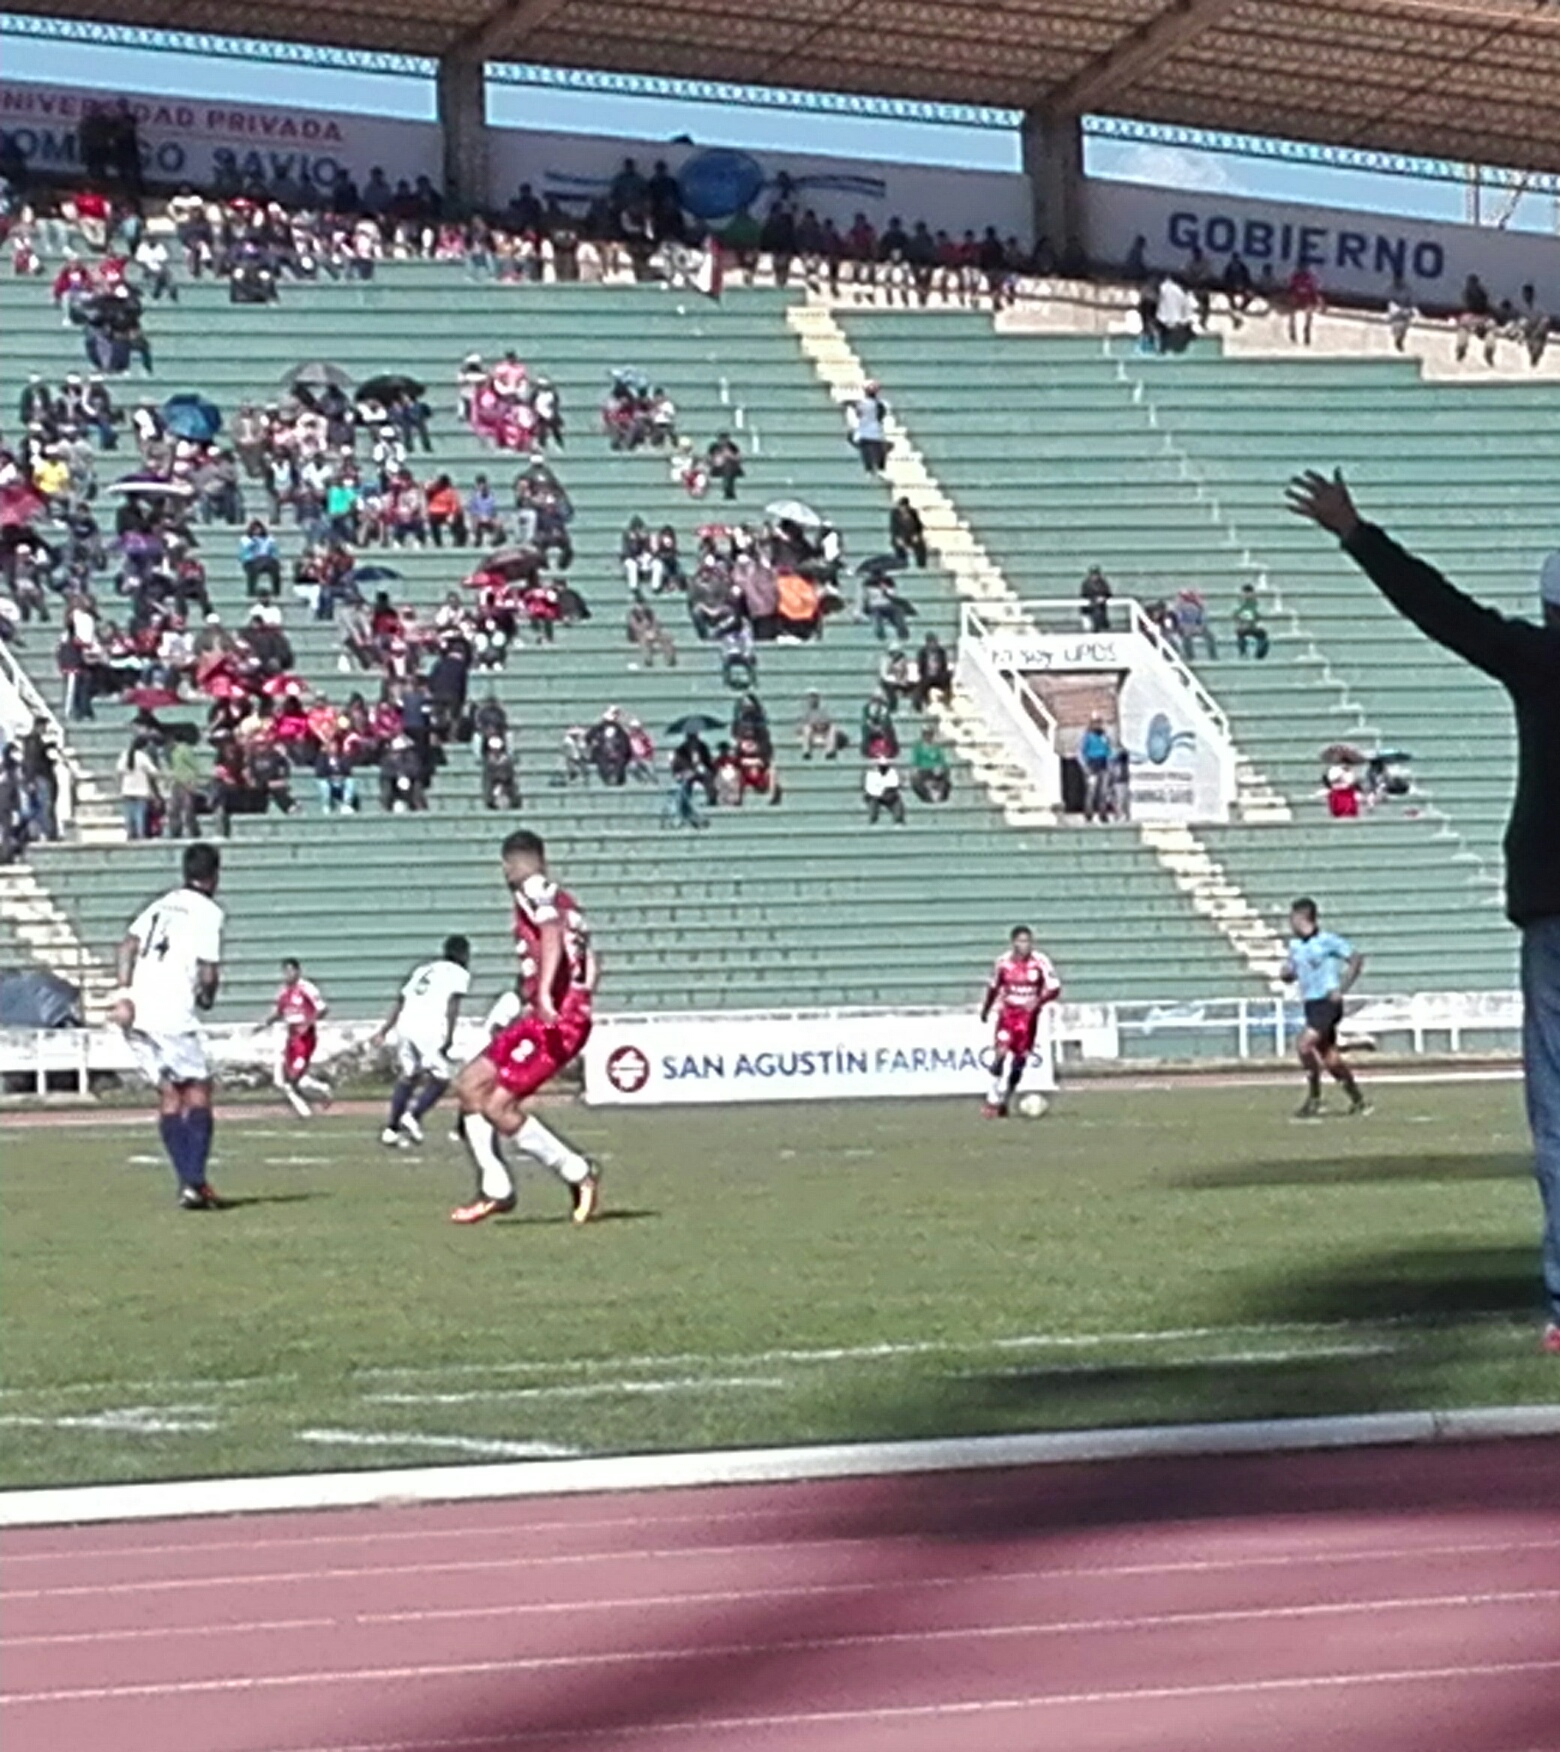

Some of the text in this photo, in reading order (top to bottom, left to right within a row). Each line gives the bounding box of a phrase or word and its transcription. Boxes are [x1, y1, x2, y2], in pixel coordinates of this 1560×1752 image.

[207, 109, 341, 141] PRIVADA
[1168, 212, 1444, 279] GOBIERNO
[141, 912, 170, 962] 14
[662, 1042, 1043, 1080] SAN AGUSTÍN FARMACS
